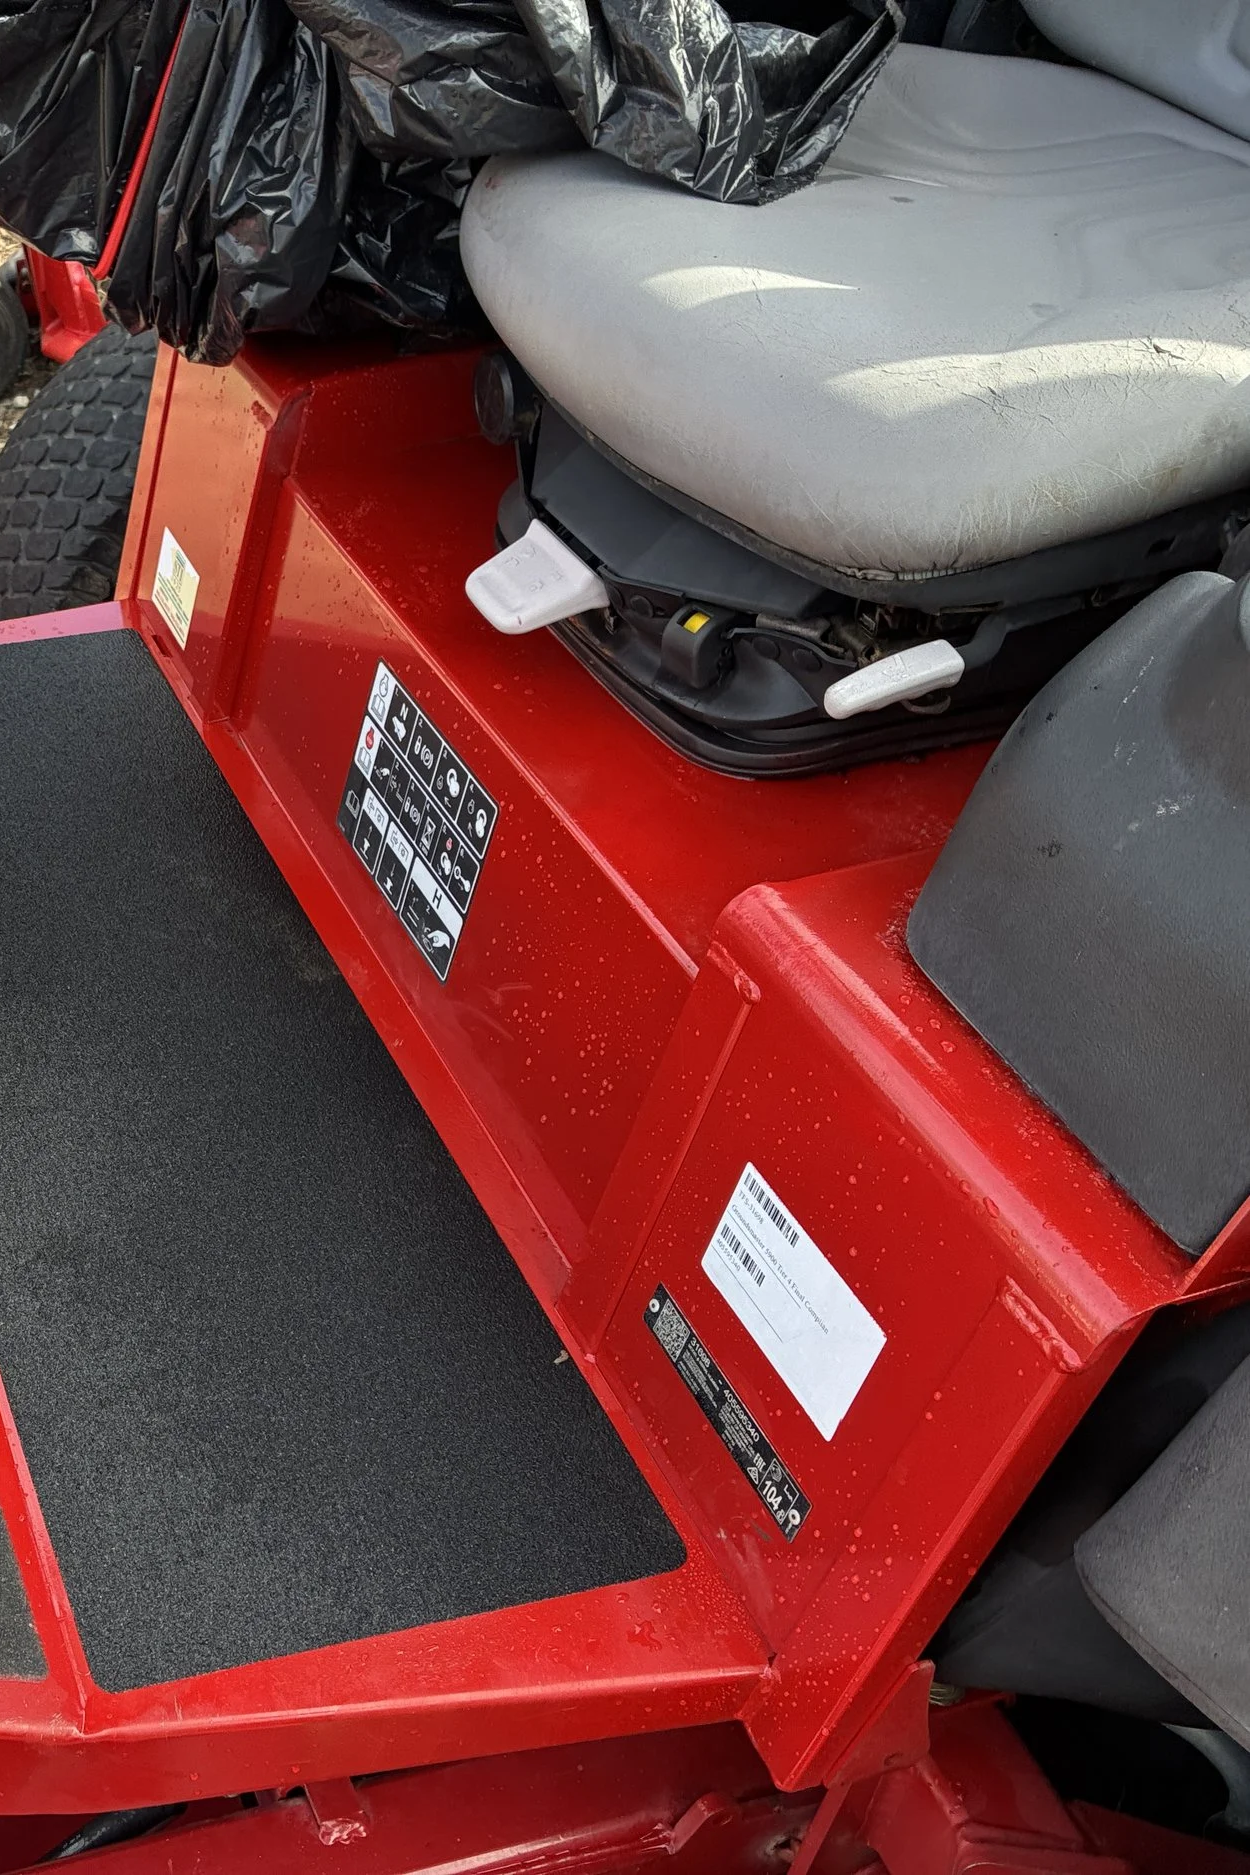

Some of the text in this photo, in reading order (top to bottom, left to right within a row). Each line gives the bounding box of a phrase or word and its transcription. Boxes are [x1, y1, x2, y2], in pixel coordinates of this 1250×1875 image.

[399, 702, 408, 721] N
[432, 887, 442, 909] H
[731, 1202, 765, 1250] Groundsmaster
[776, 1262, 788, 1281] Tier
[786, 1276, 792, 1286] 4
[791, 1282, 805, 1302] Final
[762, 1479, 783, 1511] 104
